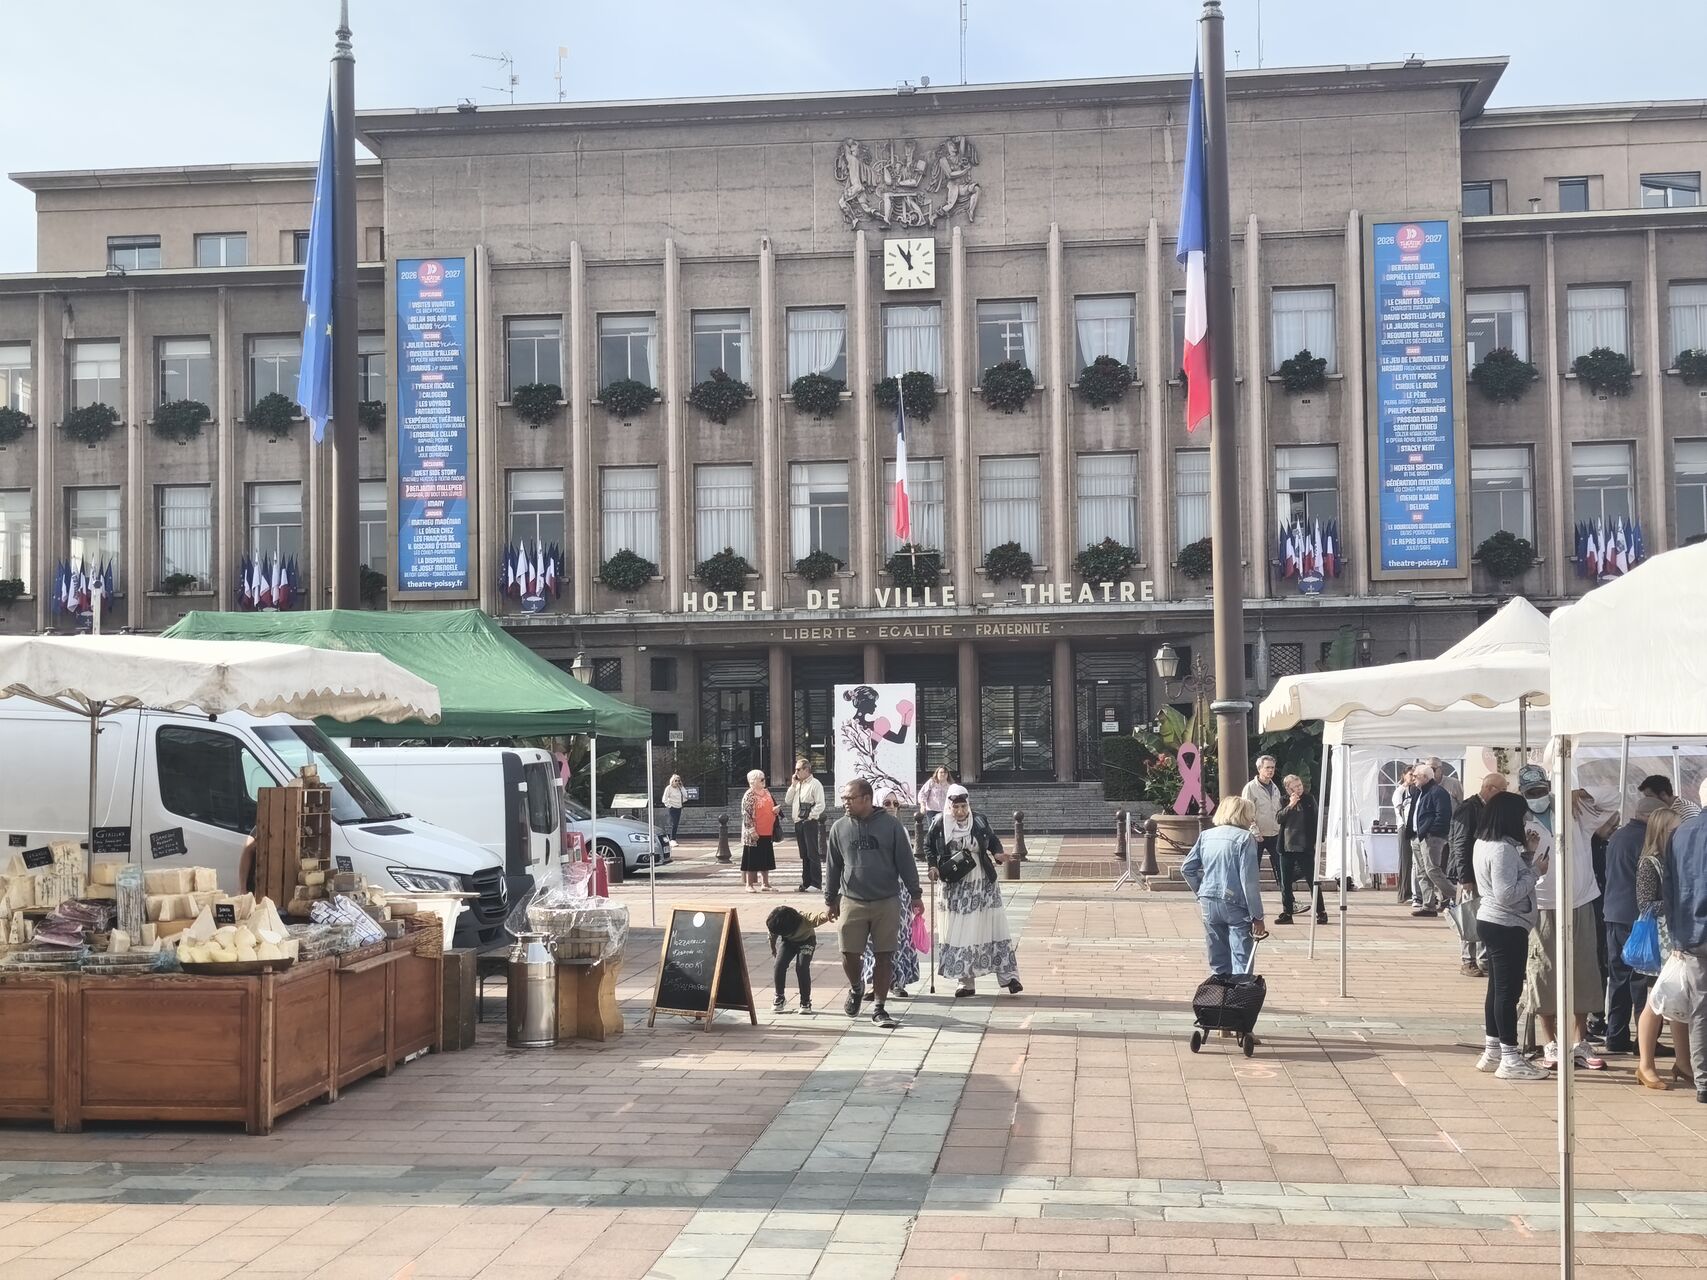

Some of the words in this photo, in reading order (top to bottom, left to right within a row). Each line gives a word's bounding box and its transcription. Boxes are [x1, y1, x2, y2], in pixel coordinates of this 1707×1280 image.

[1386, 272, 1407, 280] ORPHÉE
[1401, 312, 1445, 320] CASTELLO-LOPES
[1413, 390, 1427, 398] PÈRE
[415, 407, 451, 415] FANTASTIQUES
[405, 416, 438, 424] L'EXPÉRIENCE
[425, 444, 453, 452] MISÉRABLE
[414, 469, 429, 477] WEST
[1386, 479, 1417, 487] GÉNÉRATION
[423, 535, 447, 543] FRANÇAIS
[1389, 559, 1449, 567] theatre-poissy.fr
[407, 580, 463, 588] theatre-poissy.fr
[682, 590, 774, 612] HOTEL
[807, 589, 840, 610] DE
[874, 585, 956, 608] VILLE
[1021, 581, 1154, 604] THEATRE
[783, 627, 856, 640] LIBERTE
[879, 625, 952, 637] EGALITE
[976, 622, 1051, 635] FRATERNITE
